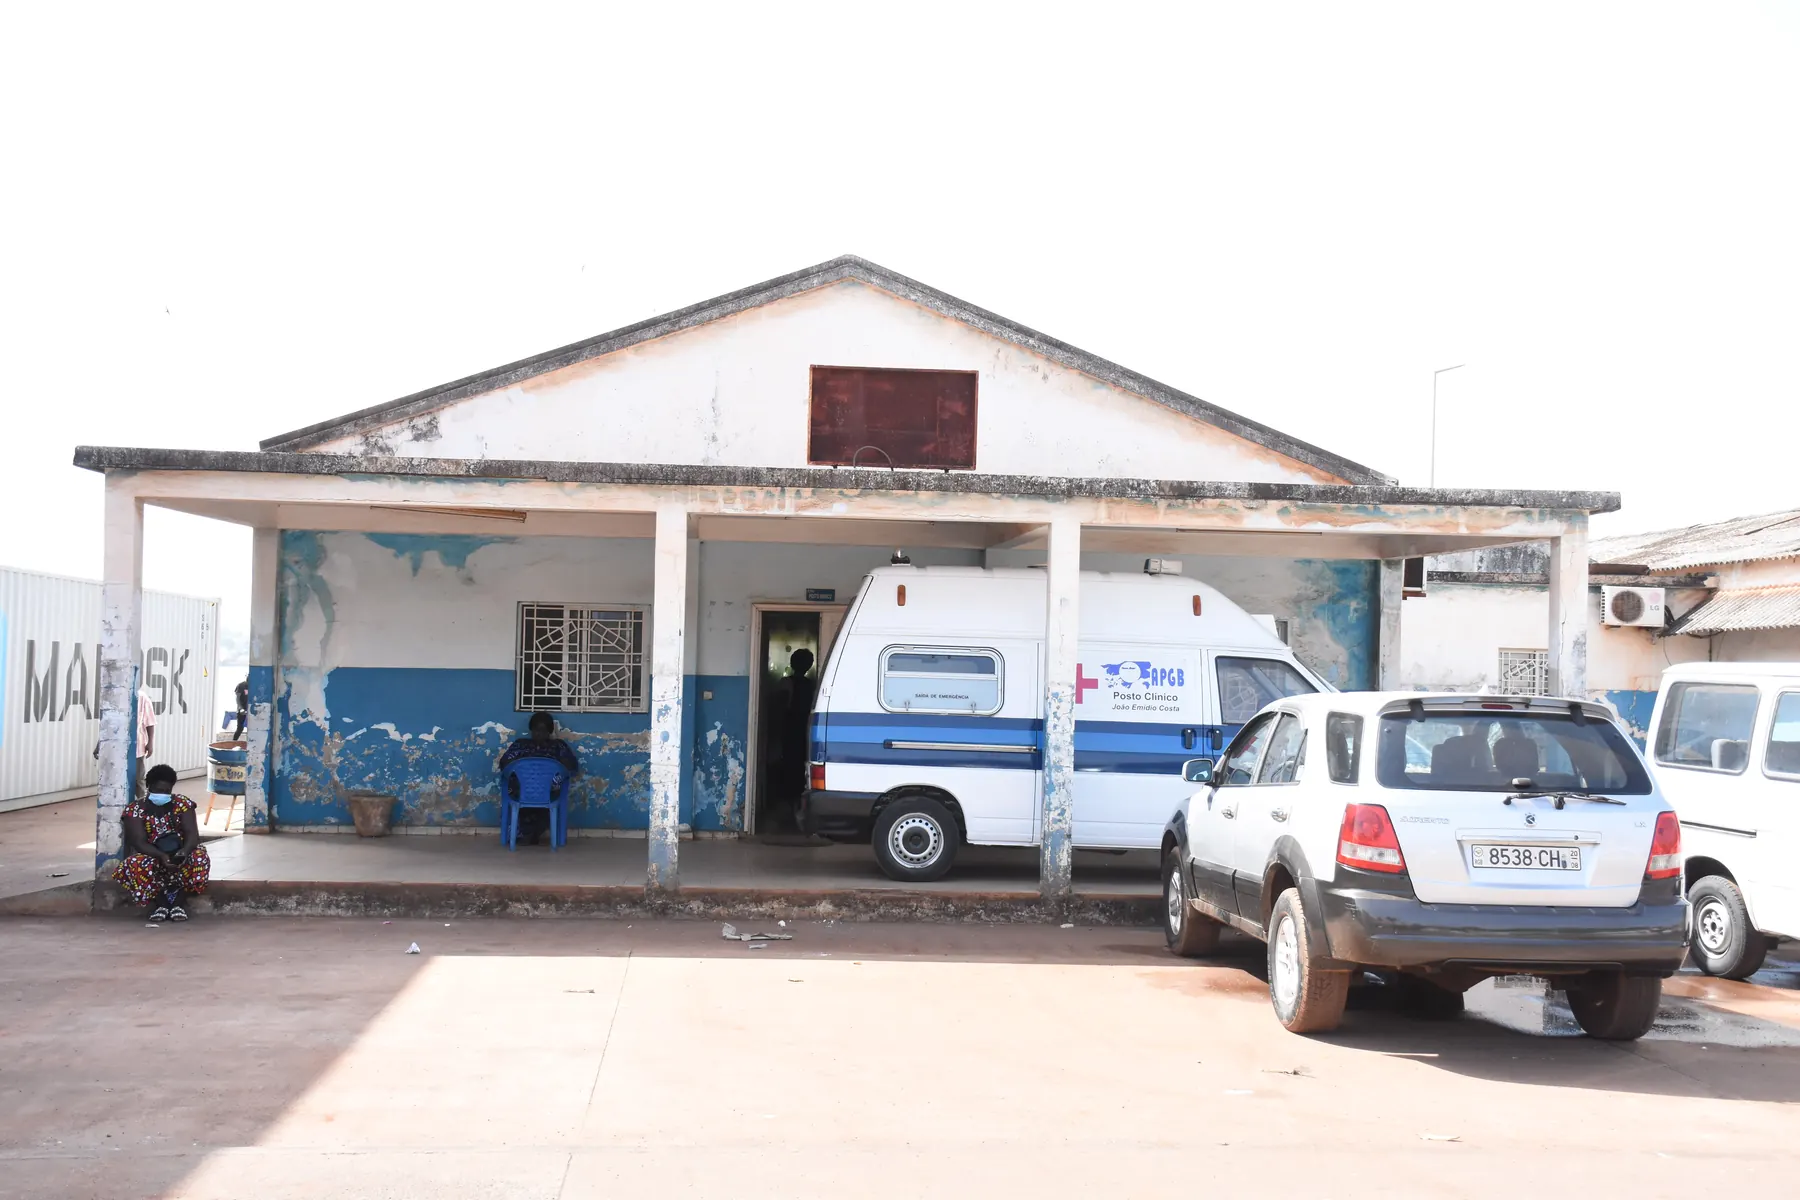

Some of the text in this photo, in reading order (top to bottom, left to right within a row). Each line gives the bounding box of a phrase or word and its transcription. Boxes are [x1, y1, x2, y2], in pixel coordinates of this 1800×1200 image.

[24, 639, 190, 724] MASK
[1151, 667, 1185, 687] APGB
[1113, 691, 1142, 701] Posto
[1112, 703, 1130, 711] João
[1158, 704, 1180, 712] Costa
